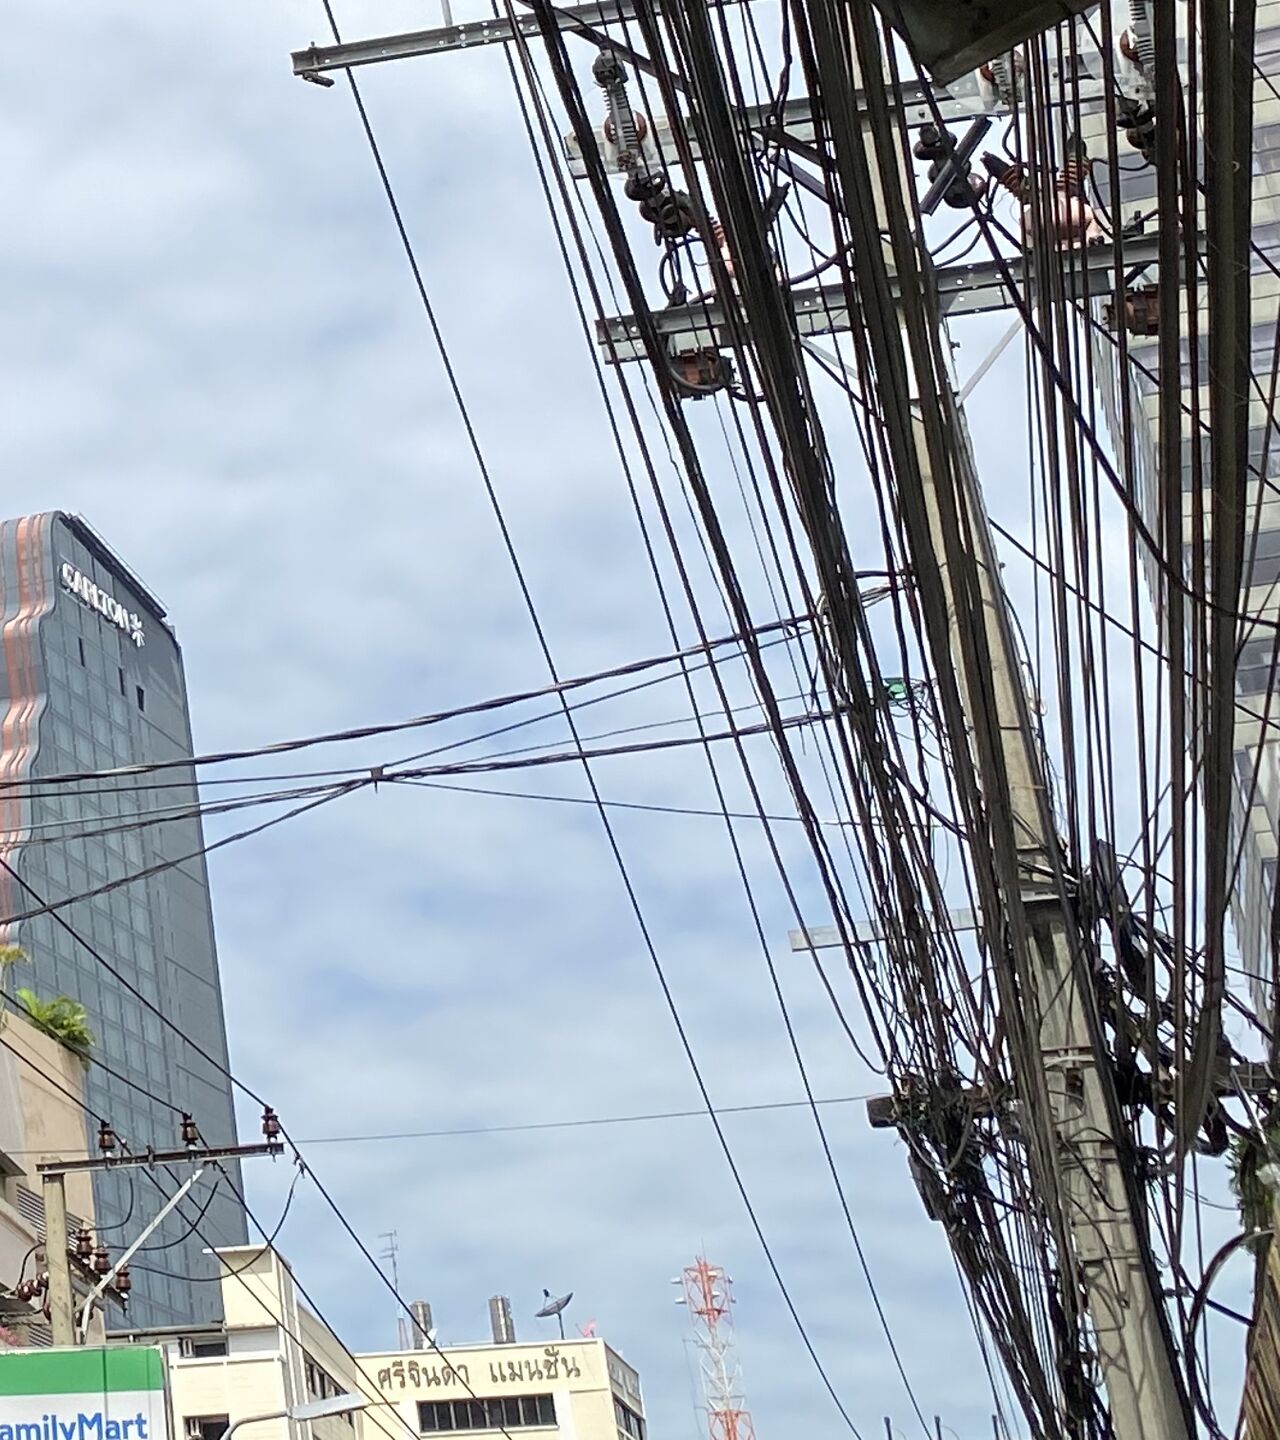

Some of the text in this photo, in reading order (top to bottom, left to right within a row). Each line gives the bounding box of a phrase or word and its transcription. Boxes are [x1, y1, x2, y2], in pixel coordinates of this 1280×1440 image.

[61, 563, 131, 635] CARLTON
[377, 1345, 582, 1390] ศรีจินดา แมนชั่น
